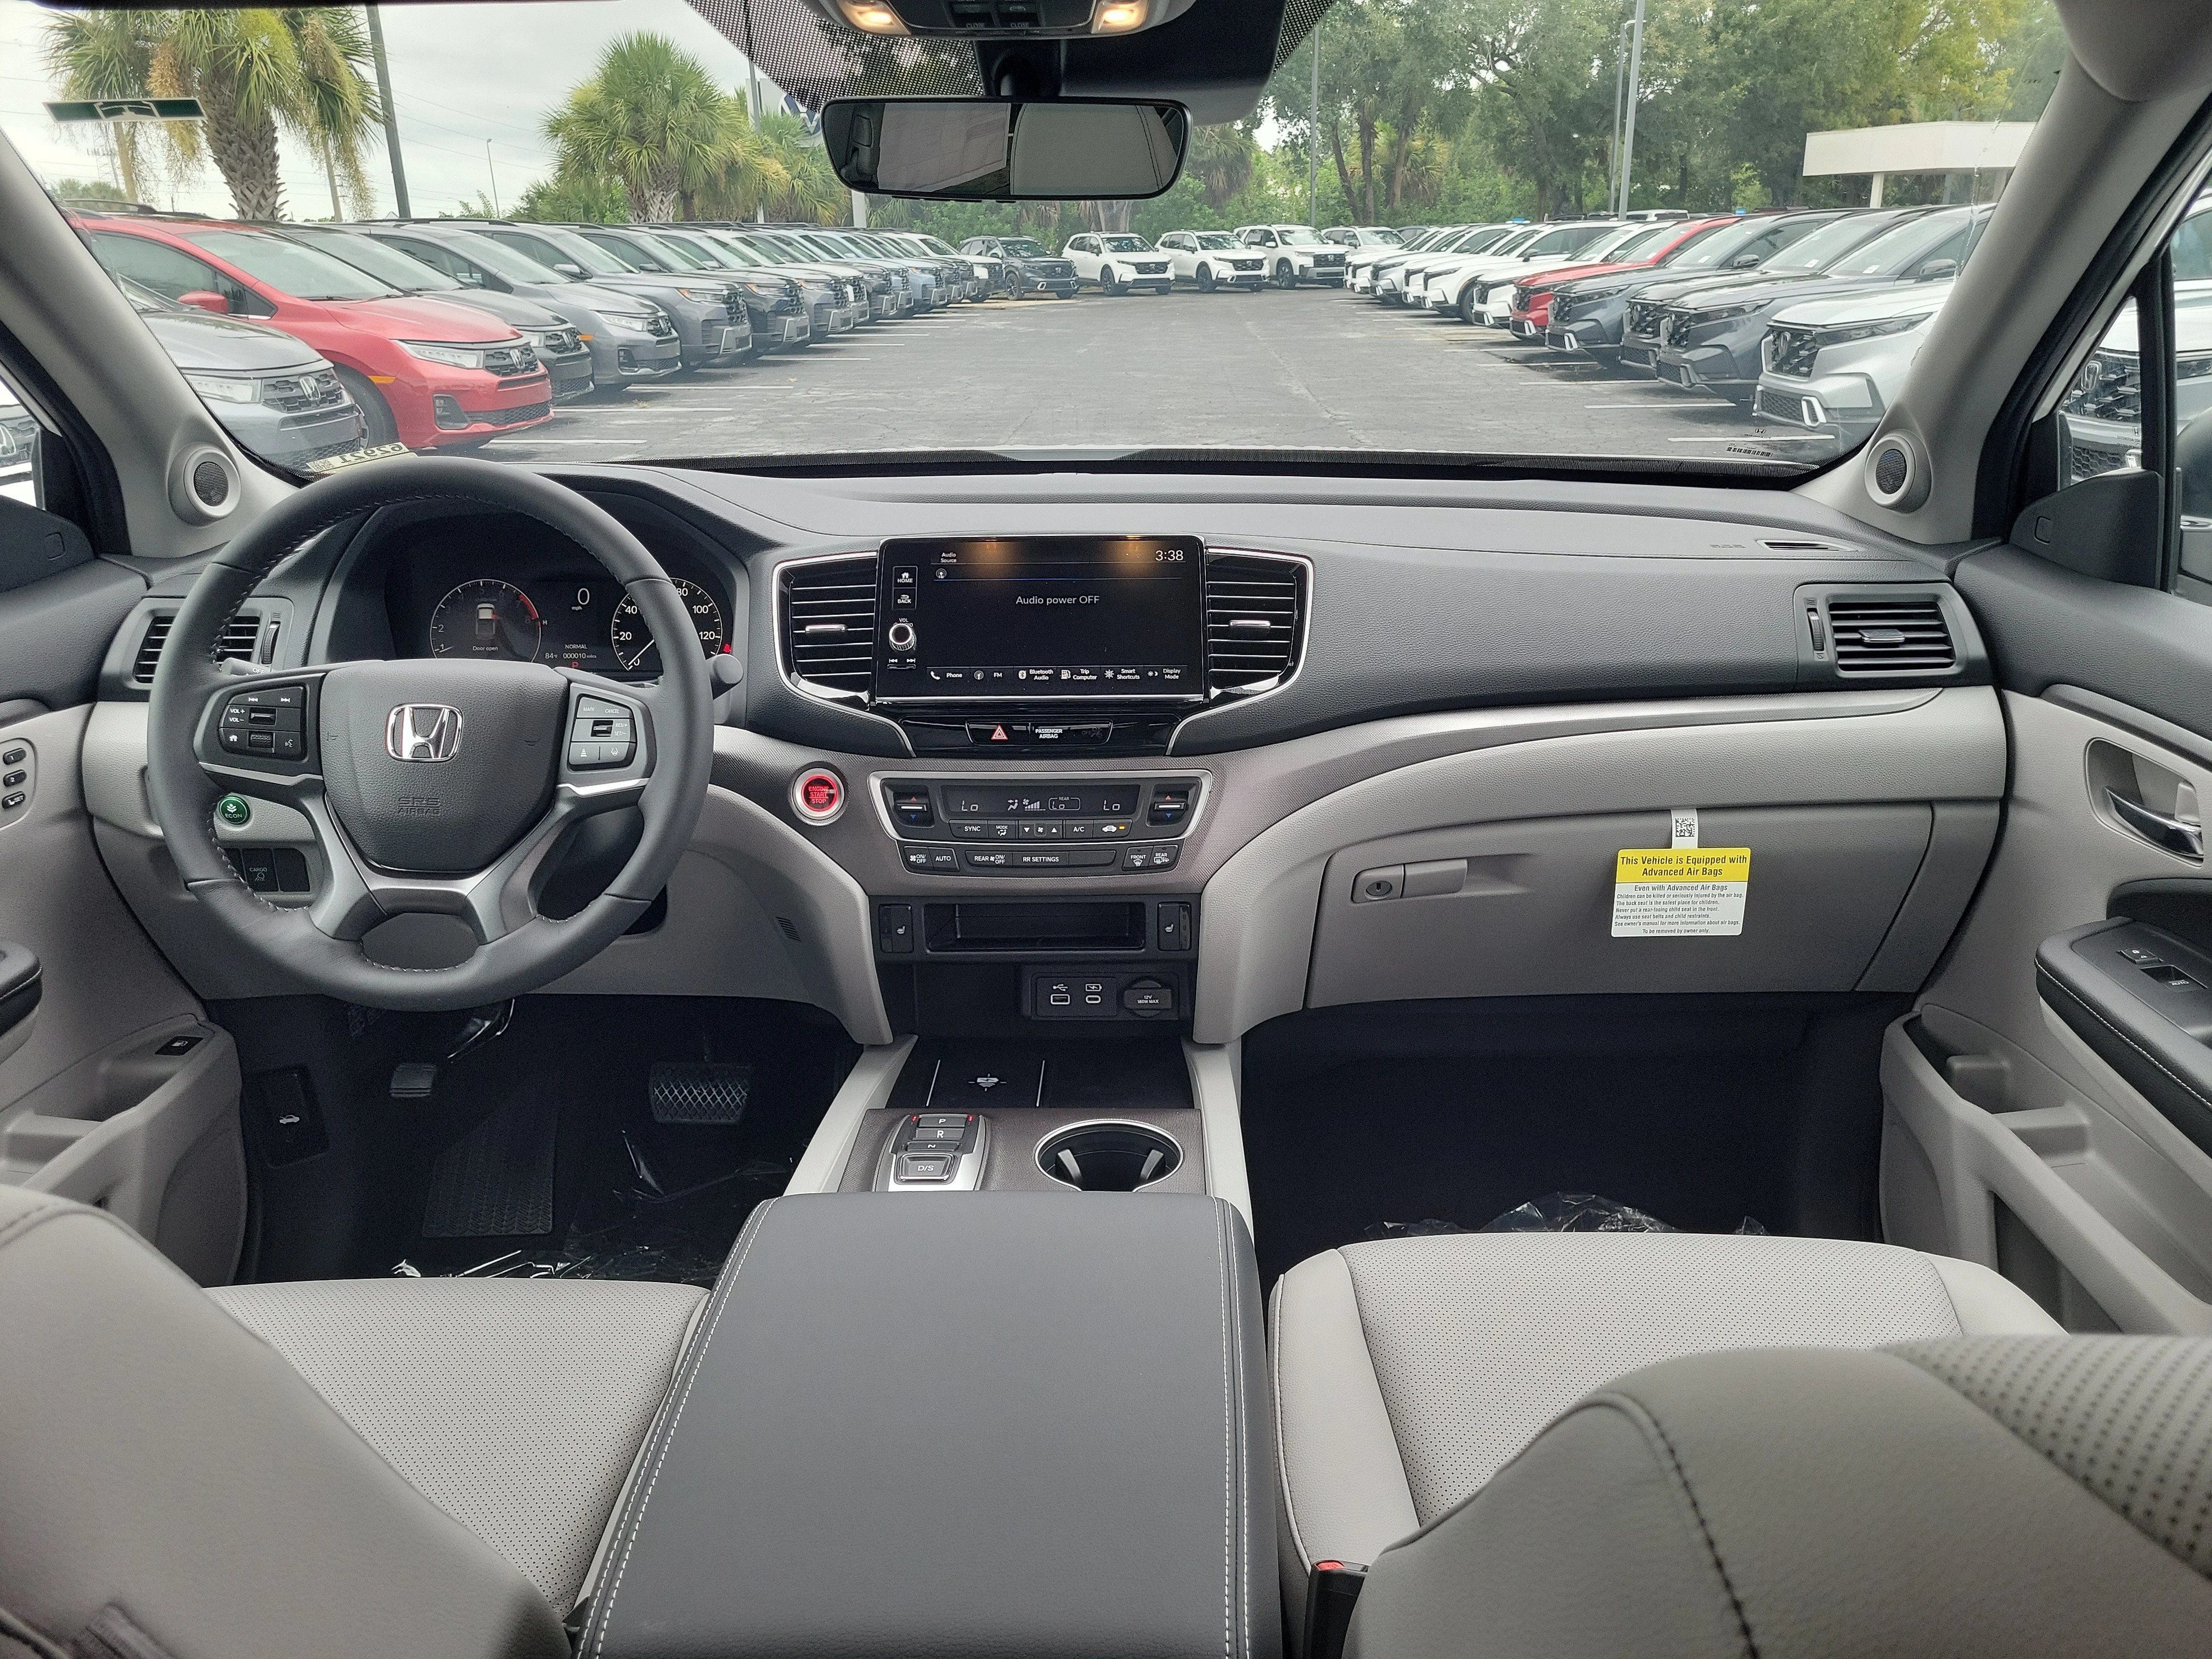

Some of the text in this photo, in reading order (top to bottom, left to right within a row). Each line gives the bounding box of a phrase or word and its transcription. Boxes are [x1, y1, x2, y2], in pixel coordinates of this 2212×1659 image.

[1155, 550, 1183, 561] 3:38
[577, 588, 590, 605] 0
[1015, 596, 1043, 604] Audio
[1046, 596, 1076, 606] power
[625, 606, 637, 614] 40
[692, 605, 709, 614] 100
[619, 631, 631, 640] 20
[699, 631, 715, 640] 120
[961, 800, 978, 811] Lo
[1052, 801, 1065, 810] Lo
[1103, 799, 1120, 811] Lo
[1620, 855, 1747, 866] This Vehicle is Equipped with
[1641, 867, 1723, 877] Advanced Air Bags
[936, 1130, 944, 1138] R
